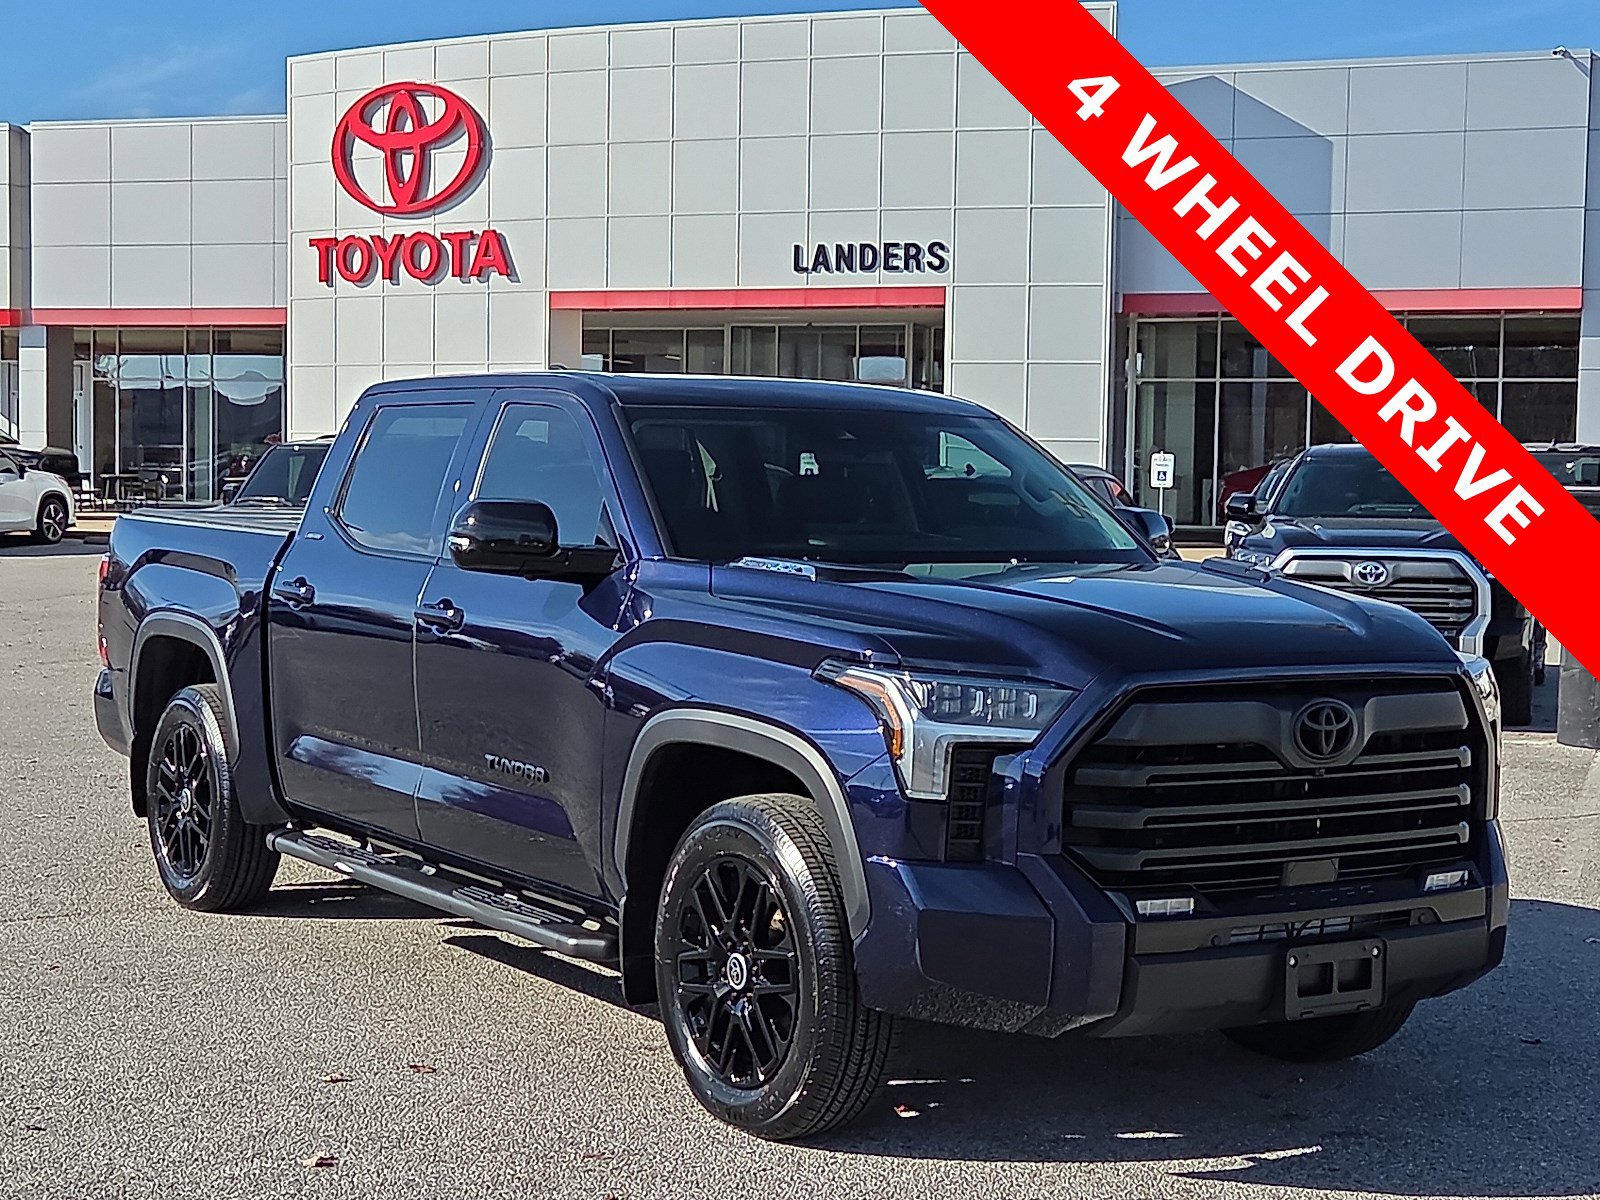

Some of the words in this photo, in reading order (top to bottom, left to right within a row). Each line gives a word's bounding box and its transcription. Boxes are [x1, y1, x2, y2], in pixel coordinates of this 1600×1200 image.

[309, 229, 512, 283] TOYOTA
[793, 241, 949, 273] LANDERS
[484, 753, 548, 784] TUNDRA
